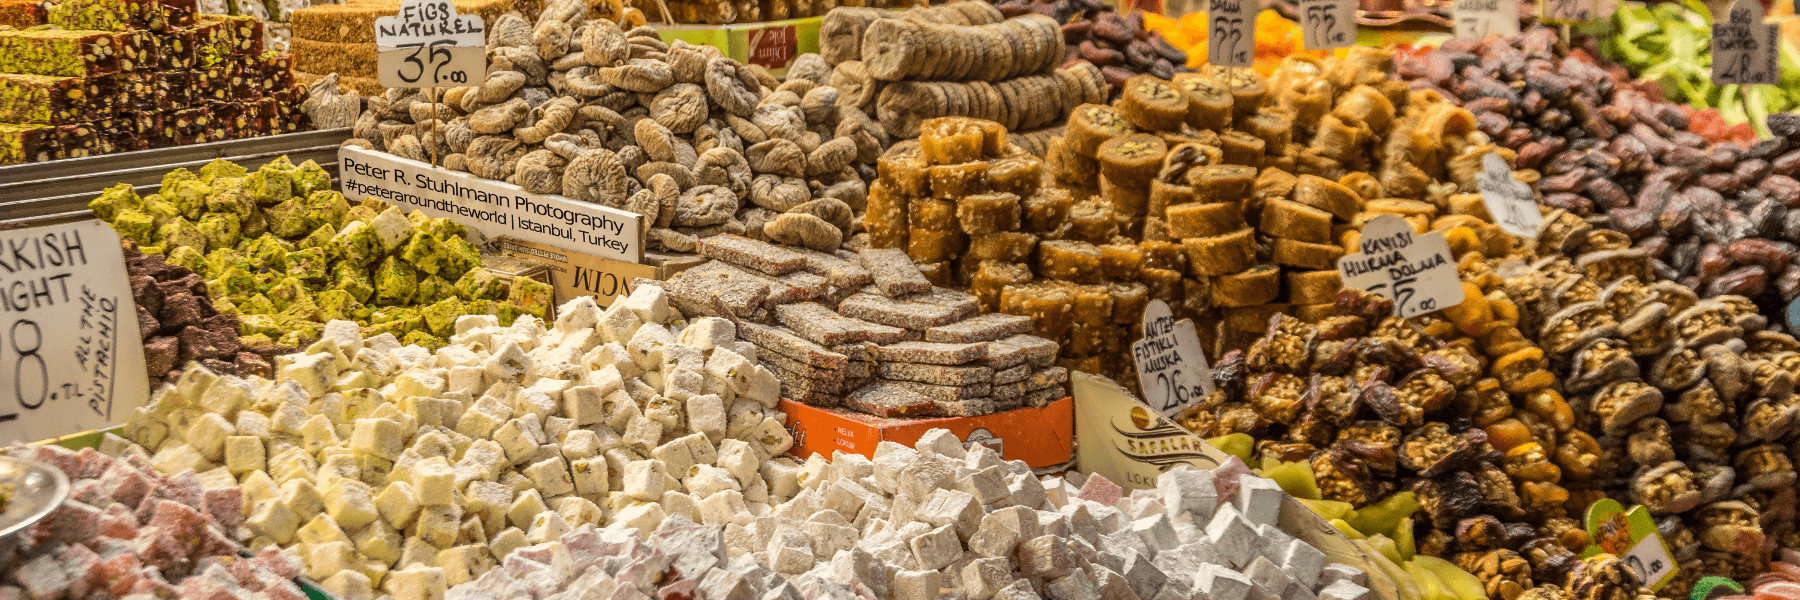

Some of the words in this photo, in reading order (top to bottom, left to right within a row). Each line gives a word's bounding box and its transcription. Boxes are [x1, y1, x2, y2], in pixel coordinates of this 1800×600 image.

[379, 18, 483, 38] NATUREL
[79, 283, 97, 331] THE
[74, 335, 92, 372] ALL
[1127, 436, 1204, 455] SAFALAR
